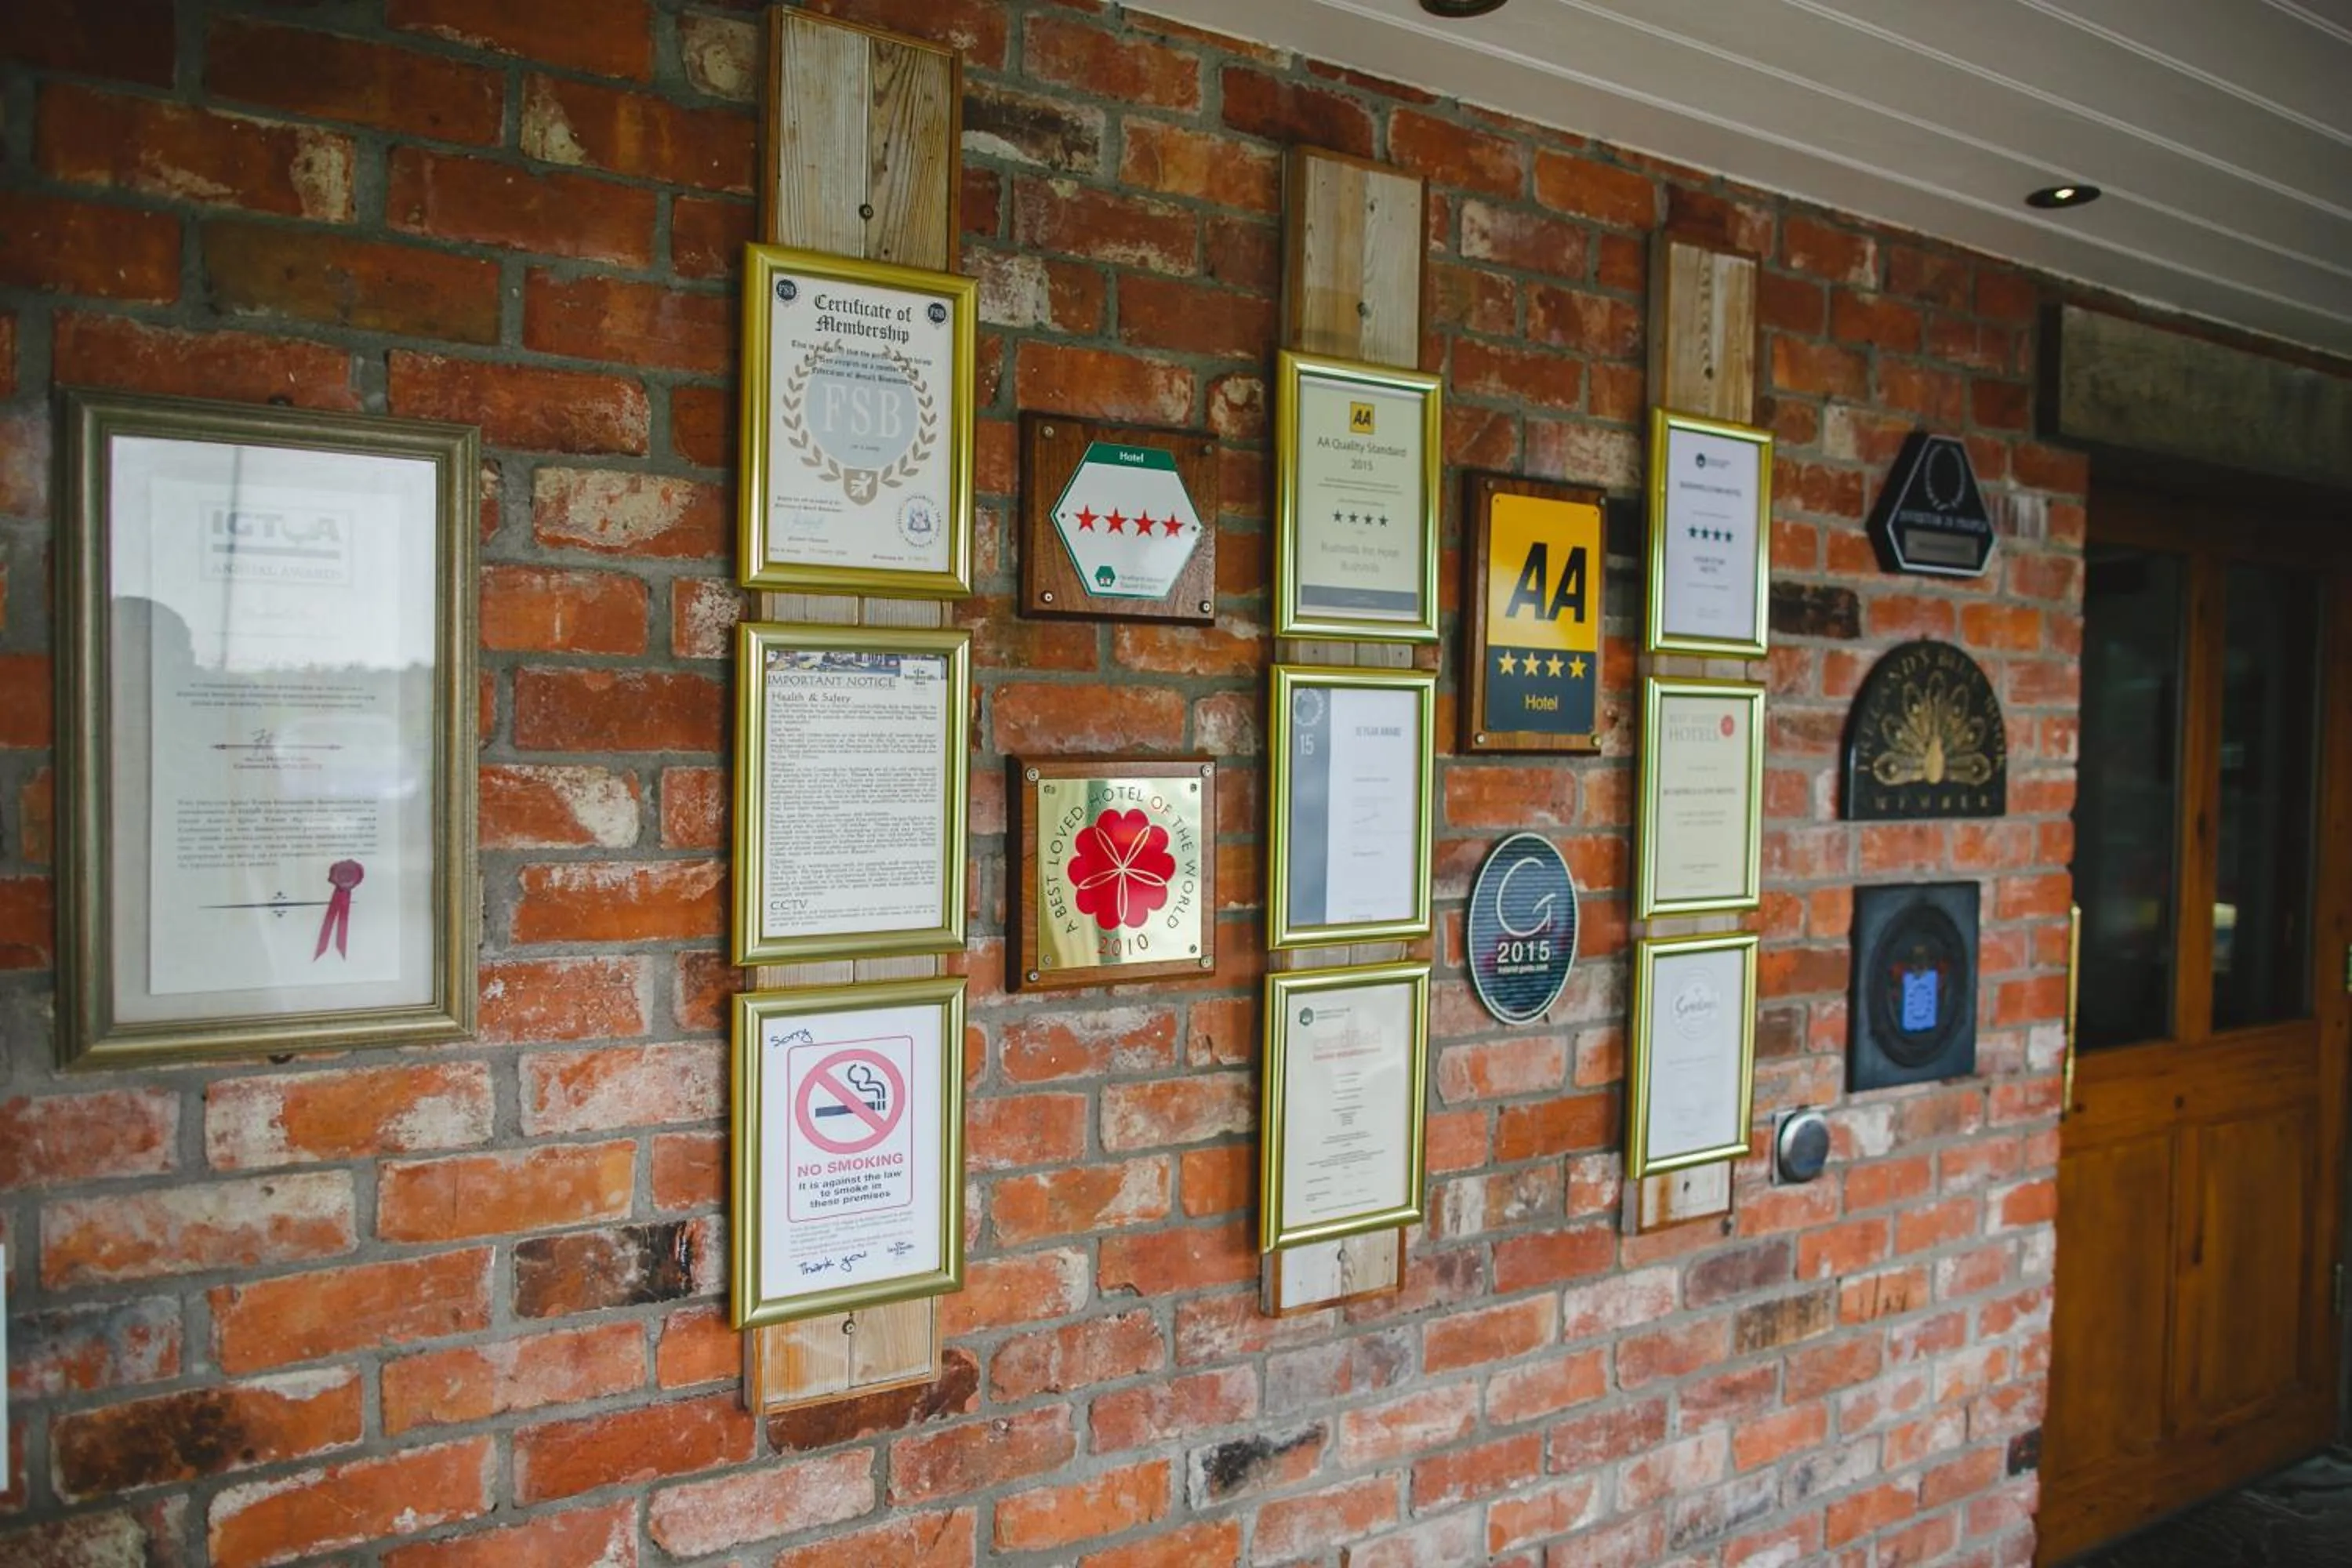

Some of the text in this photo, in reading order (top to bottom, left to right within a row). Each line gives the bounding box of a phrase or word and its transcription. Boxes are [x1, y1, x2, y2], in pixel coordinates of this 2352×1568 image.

[815, 294, 912, 322] Certificate of
[815, 314, 909, 344] Membership
[823, 383, 902, 438] FSB
[1353, 410, 1371, 426] AA
[1120, 451, 1144, 463] Hotel
[1317, 436, 1406, 458] AA Quality Standard
[1504, 541, 1587, 623] AA
[768, 674, 842, 688] IMPORTANT
[846, 676, 895, 689] NOTICE
[771, 691, 851, 704] Health & Safety
[1525, 694, 1559, 711] Hotel
[1300, 733, 1315, 755] 15
[1047, 786, 1199, 935] A BEST LOVED HOTEL OF THE WORLD
[770, 899, 808, 911] CCTV
[1098, 933, 1149, 956] 2010
[1497, 939, 1550, 964] 2015
[771, 1028, 813, 1047] Sorry
[797, 1152, 904, 1177] NO SMOKING
[810, 1181, 818, 1189] is
[822, 1176, 862, 1189] against
[864, 1172, 881, 1181] the
[884, 1171, 902, 1179] law
[833, 1184, 869, 1196] smoke
[810, 1191, 891, 1208] these premises
[798, 1251, 866, 1276] Thank you
